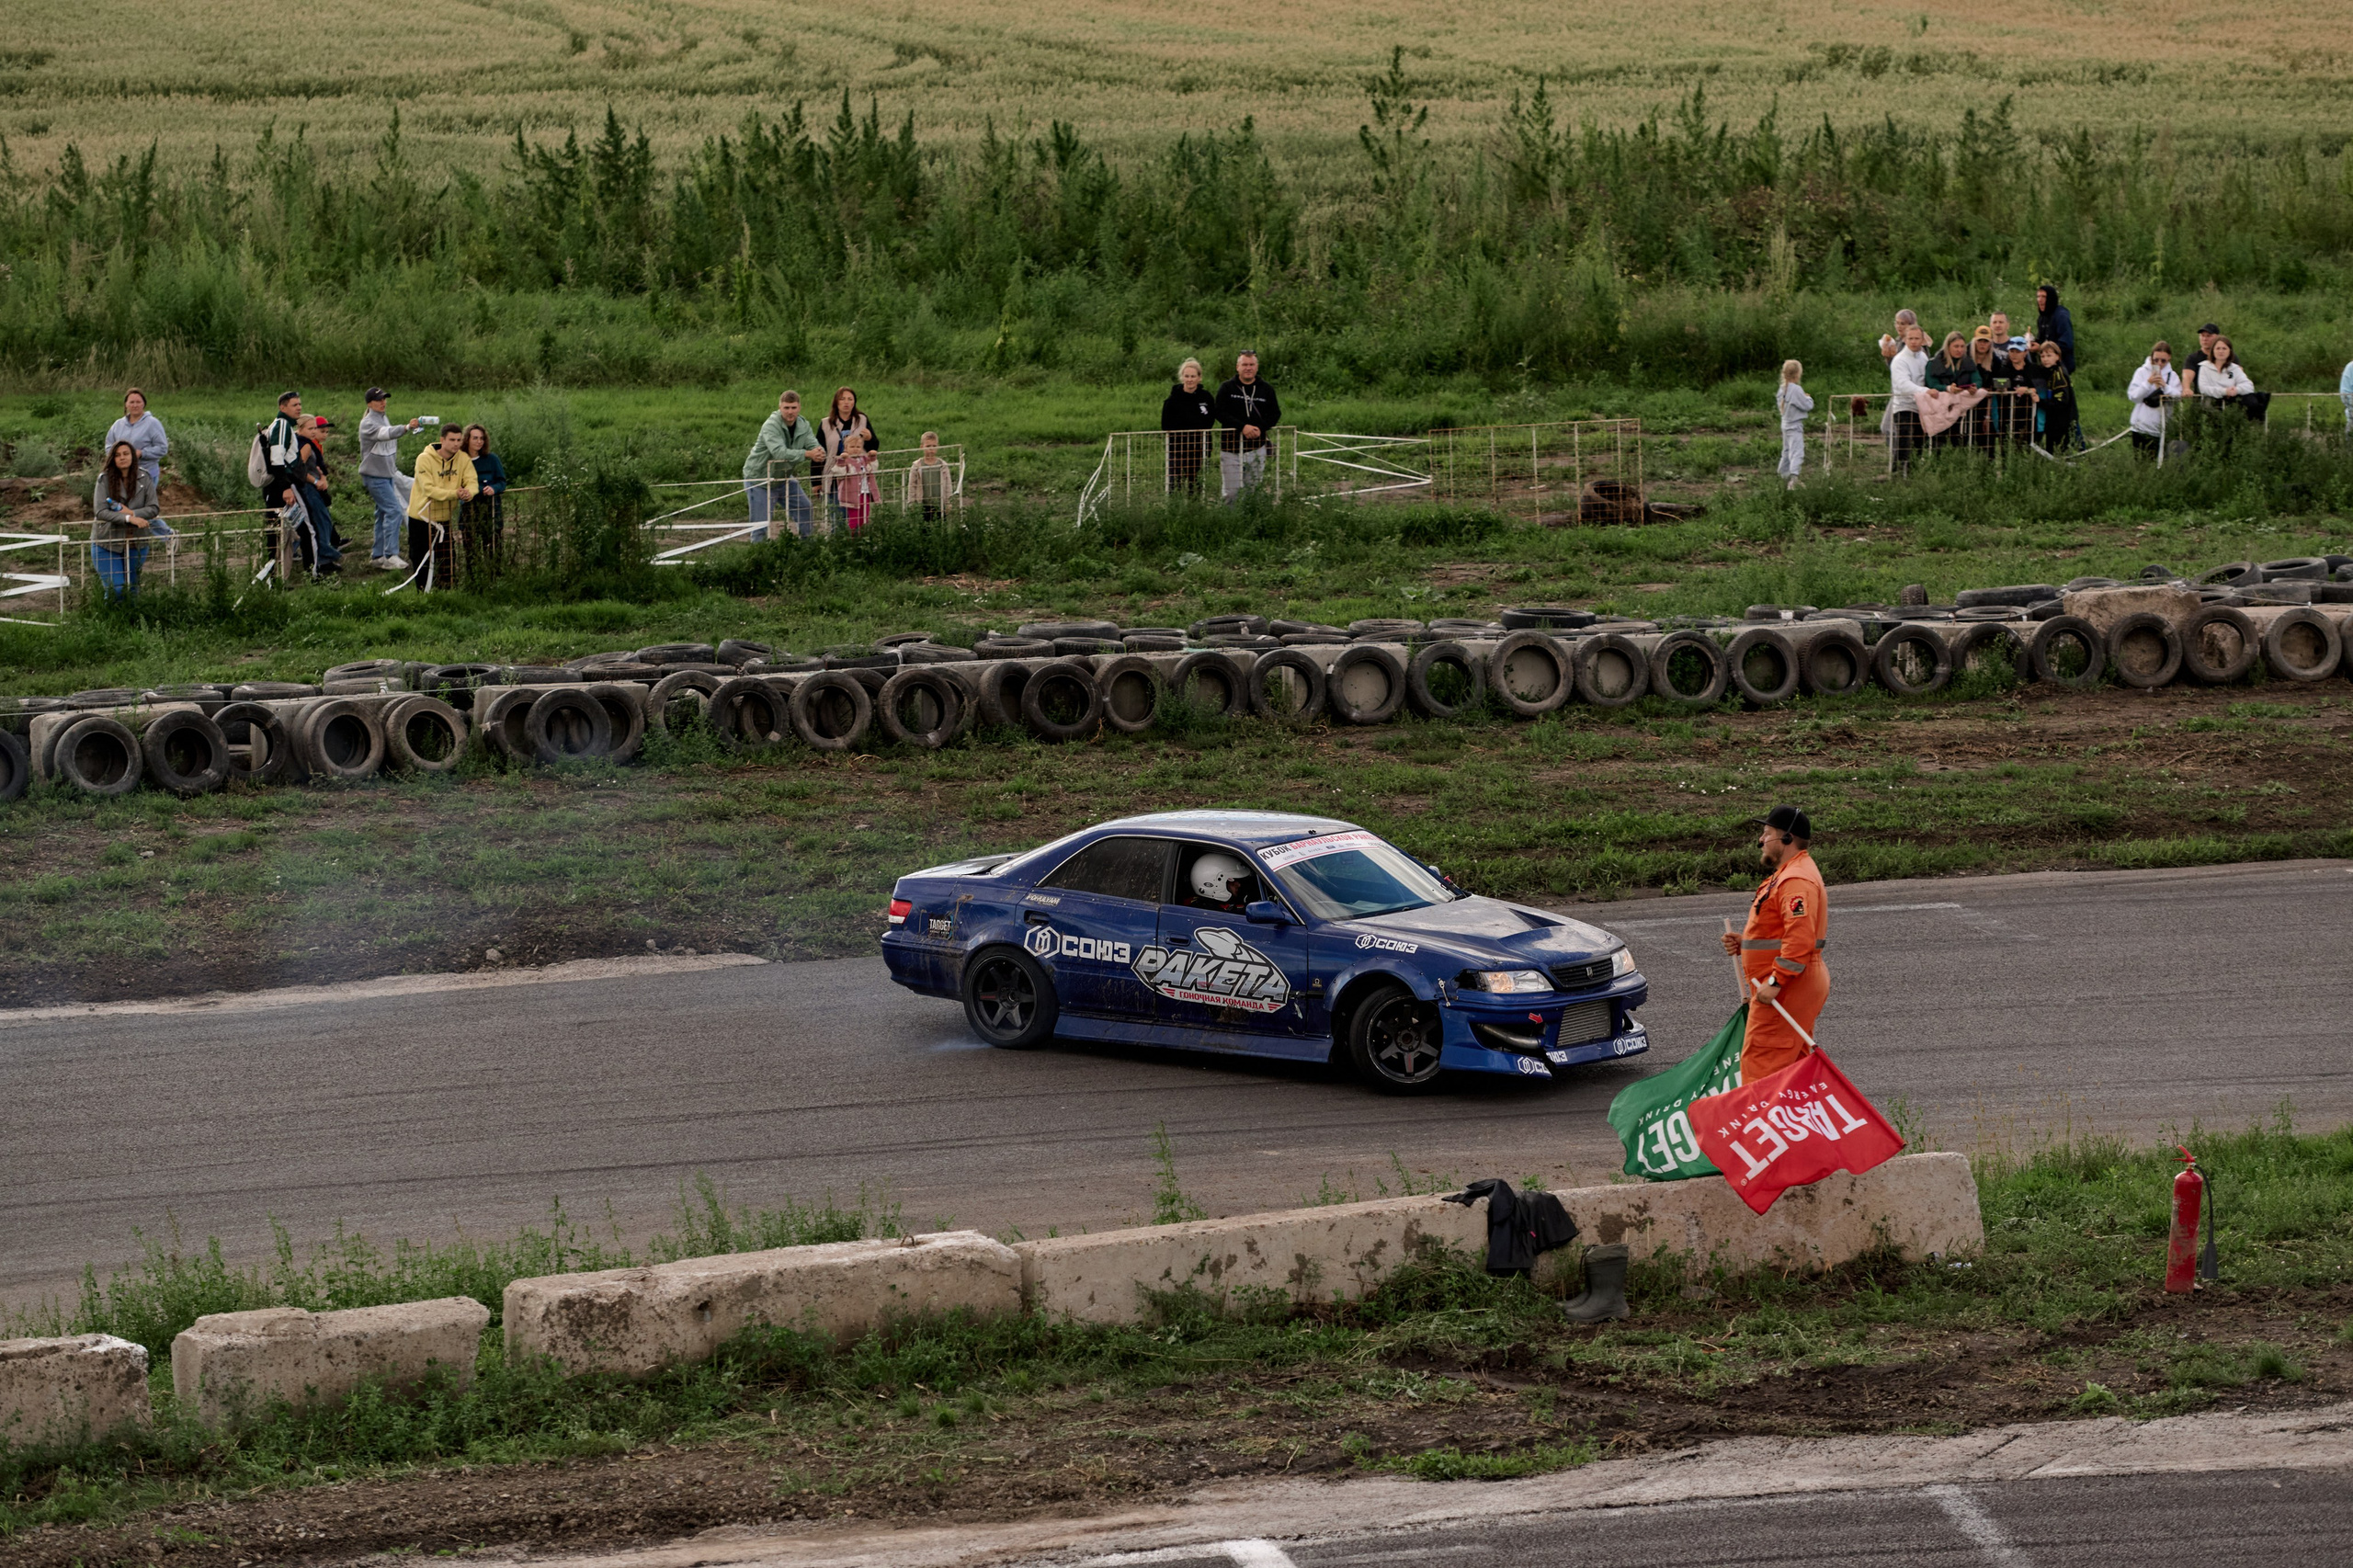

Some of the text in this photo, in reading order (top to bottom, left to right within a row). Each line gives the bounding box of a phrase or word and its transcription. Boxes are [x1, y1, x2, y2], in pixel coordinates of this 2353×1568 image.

[1259, 845, 1291, 860] КУБОК
[1290, 834, 1354, 850] БАРНАУЛЬСКОЙ
[928, 918, 951, 931] TARGET
[1062, 935, 1131, 963] СОЮЗ
[1375, 937, 1418, 954] СОЮЗ
[1134, 946, 1287, 1000] РАКЕТА
[1179, 992, 1265, 1010] ГОНОЧНАЯ КОМАНДА
[1626, 1035, 1647, 1051] СОЮЗ
[1638, 1098, 1682, 1127] DRINK
[1717, 1082, 1828, 1139] ENERGY DRINK
[1729, 1094, 1869, 1181] TARGET
